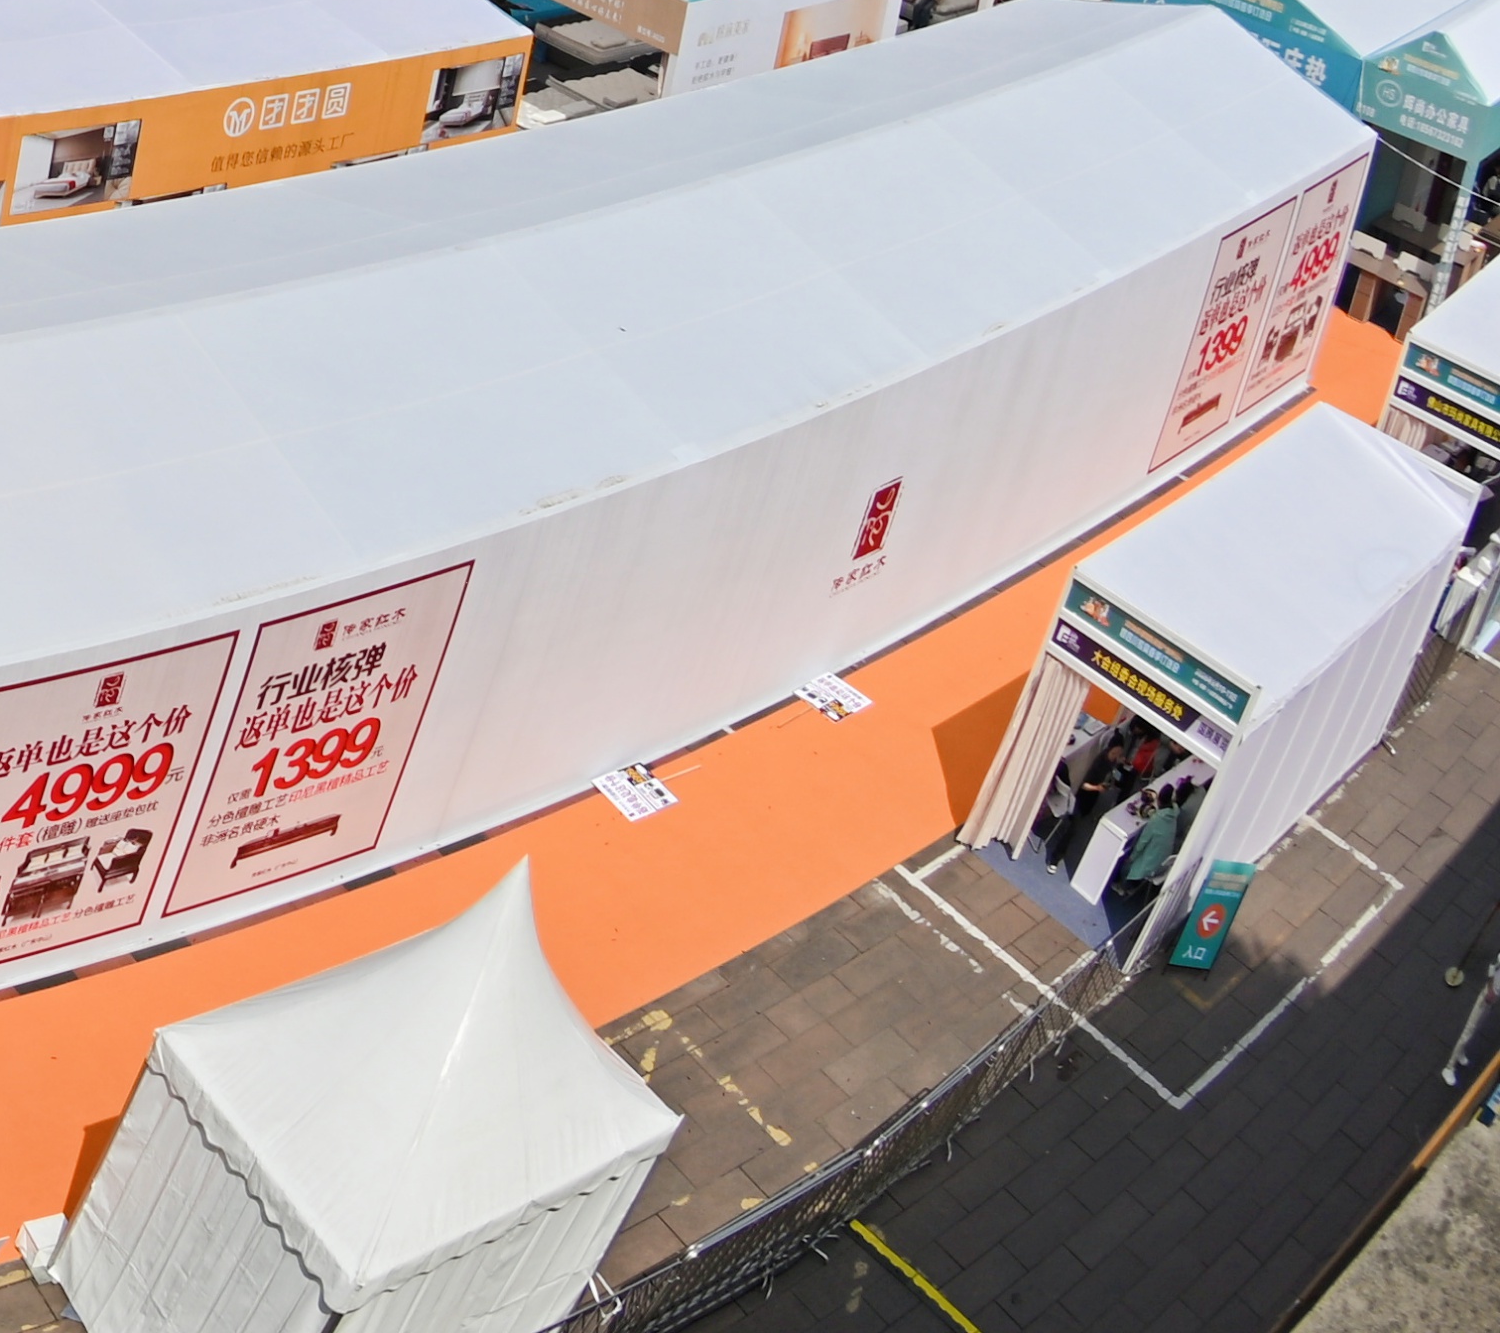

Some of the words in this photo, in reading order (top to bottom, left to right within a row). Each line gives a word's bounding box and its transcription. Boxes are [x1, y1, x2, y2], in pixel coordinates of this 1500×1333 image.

[259, 82, 352, 128] 团团圆
[209, 133, 356, 175] 值得您信赖的源头工厂
[1197, 315, 1249, 376] 1399
[1289, 230, 1341, 290] 4999
[342, 607, 407, 636] 传家红木
[235, 663, 419, 750] 返单也是这个价
[256, 641, 387, 709] 行业核弹
[0, 741, 177, 830] 4999
[164, 764, 186, 786] 元
[206, 796, 289, 830] 分色檀雕工艺
[288, 759, 391, 802] 印尼黑檀精品工艺
[226, 788, 251, 806] 仅需
[249, 717, 382, 798] 1399
[199, 814, 281, 849] 非洲名贵硬木
